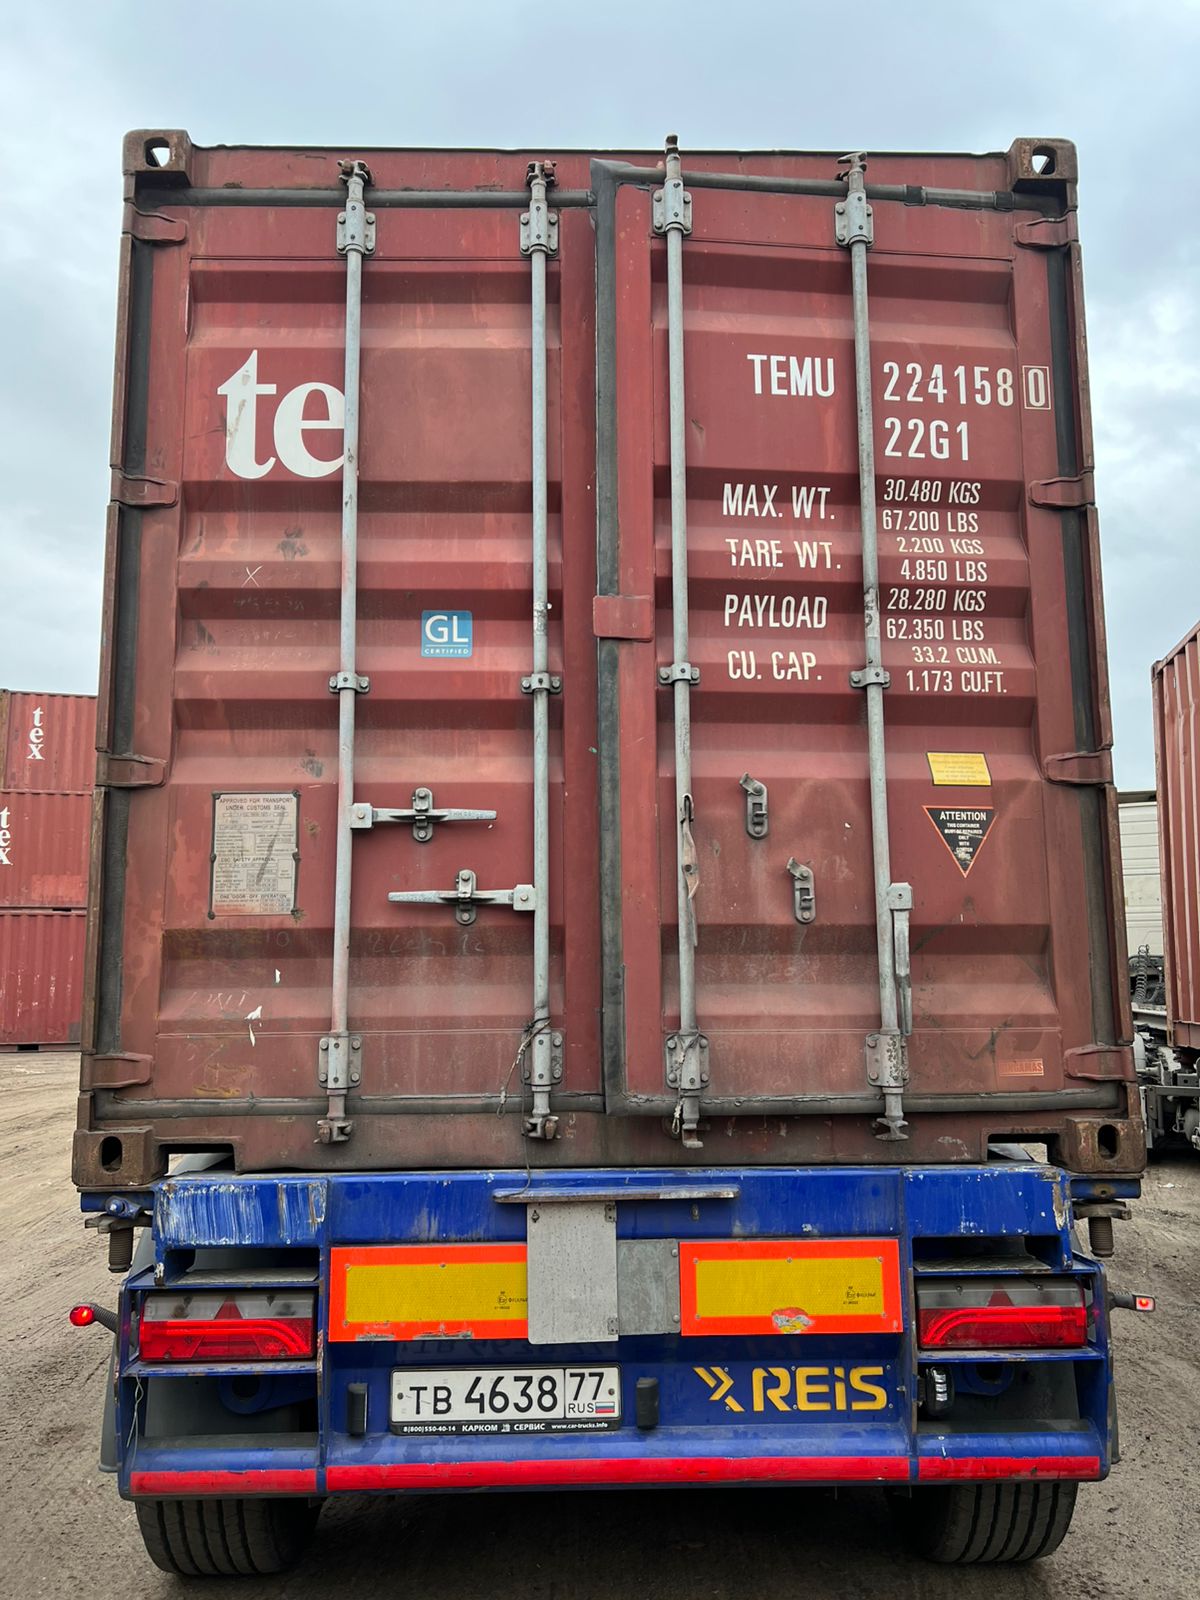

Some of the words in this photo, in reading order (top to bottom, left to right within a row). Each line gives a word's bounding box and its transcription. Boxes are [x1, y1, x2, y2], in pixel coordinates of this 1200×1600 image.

[747, 354, 835, 397] TEMU
[883, 361, 1014, 407] 224158
[1027, 368, 1046, 407] 0
[217, 349, 346, 479] te
[884, 417, 969, 461] 22G1
[722, 483, 783, 518] MAX.
[792, 485, 835, 520] WT.
[884, 478, 942, 503] 30,480
[949, 481, 981, 504] KGS
[882, 509, 940, 532] 67,200
[947, 511, 979, 533] LBS
[725, 538, 784, 568] TARE
[794, 540, 841, 569] WT.
[950, 538, 984, 555] KGS
[900, 559, 948, 581] 4,850
[955, 560, 988, 582] LBS
[724, 594, 828, 629] PAYLOAD
[887, 587, 947, 611] 28,280
[953, 589, 987, 612] KGS
[425, 615, 469, 642] GL
[886, 618, 945, 640] 62,350
[952, 619, 985, 641] LBS
[727, 650, 762, 680] CU.
[771, 651, 822, 681] CAP.
[911, 646, 951, 664] 33.2
[906, 669, 953, 692] 1,173
[939, 811, 987, 821] ATTENTION
[464, 1375, 558, 1414] 4638
[569, 1371, 605, 1401] 77
[567, 1402, 595, 1413] RUS
[461, 1424, 498, 1432] КАРКОМ
[513, 1423, 546, 1431] СЕРВИС
